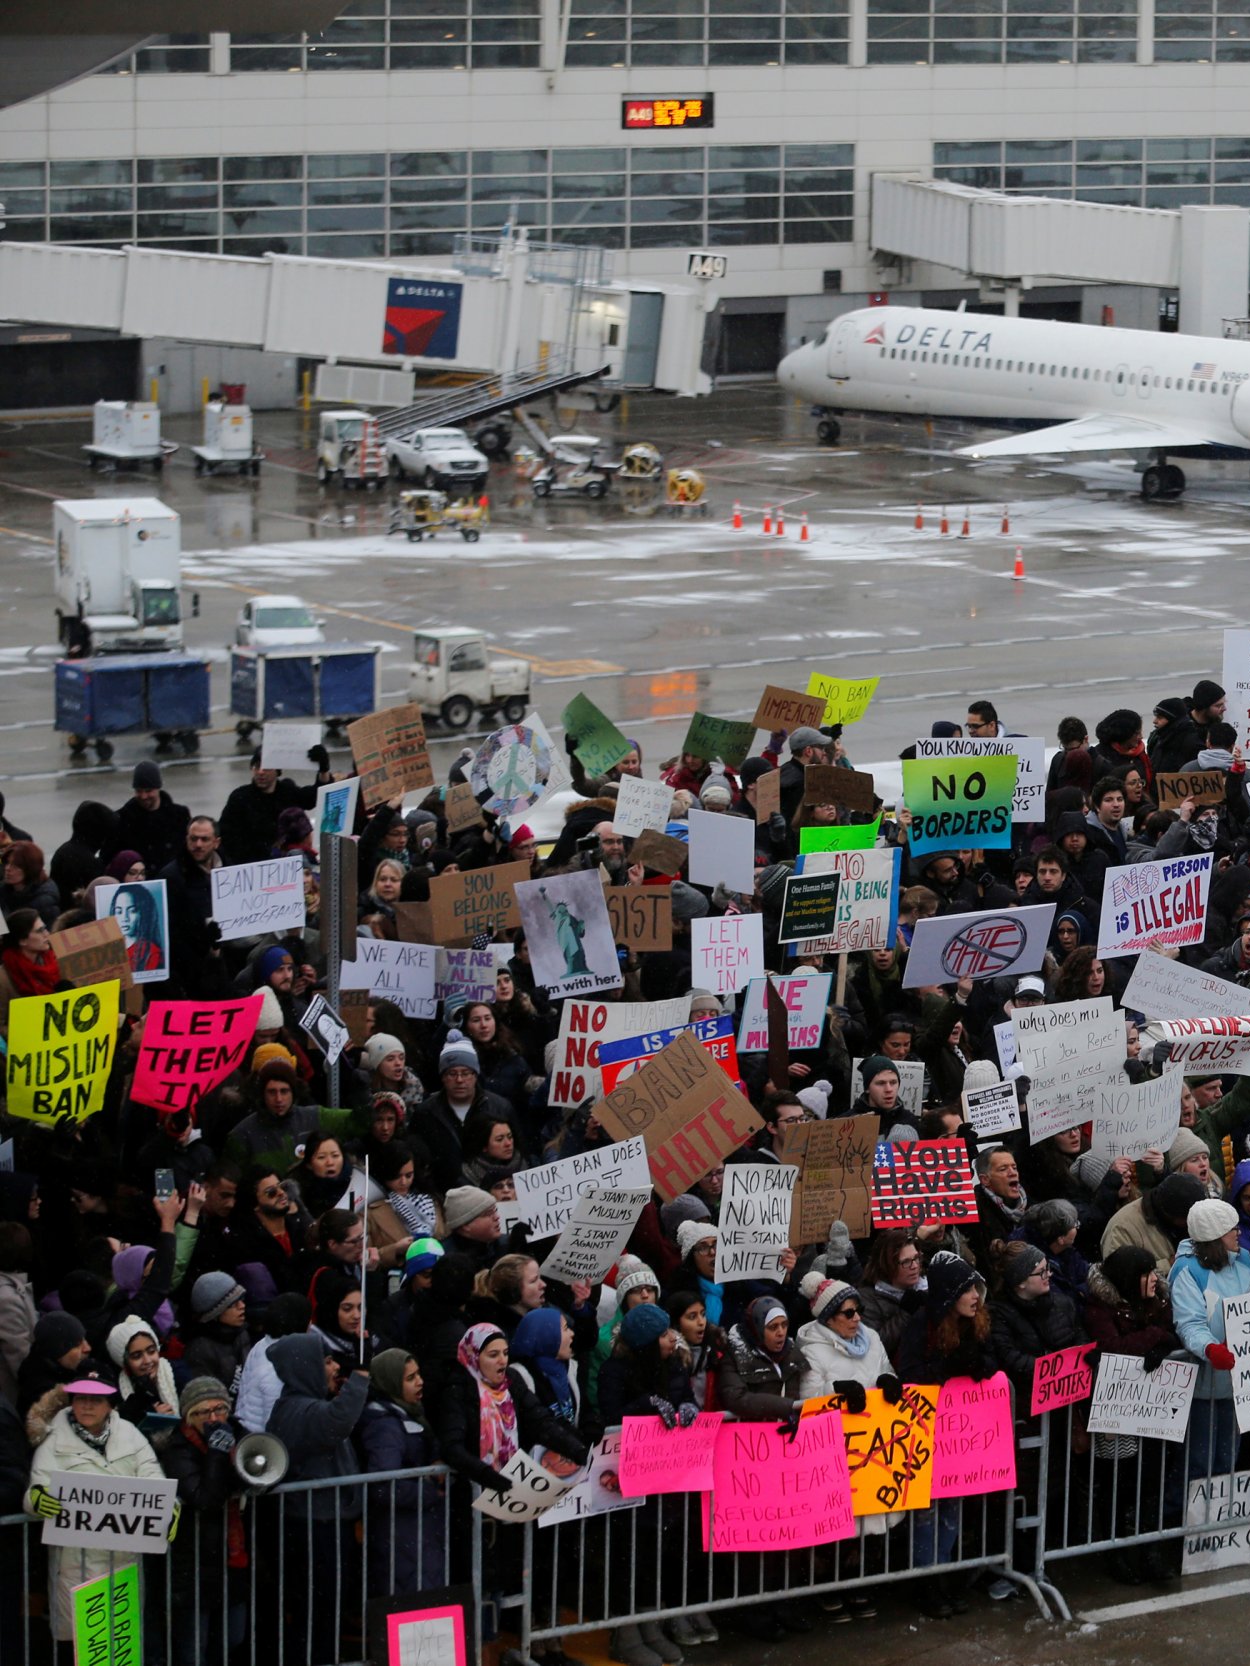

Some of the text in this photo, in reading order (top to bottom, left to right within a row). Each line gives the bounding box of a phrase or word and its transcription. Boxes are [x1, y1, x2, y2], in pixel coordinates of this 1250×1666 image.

[690, 255, 725, 277] A49
[408, 287, 445, 298] DELTA
[896, 325, 991, 352] DELTA
[817, 683, 871, 702] NO BAN
[763, 696, 821, 728] IMPEACH!
[918, 740, 943, 755] YOU
[932, 771, 986, 801] NO
[1160, 773, 1222, 800] NO BAN
[912, 806, 1008, 841] BORDERS
[215, 860, 302, 899] BAN TRUMP
[464, 872, 494, 896] YOU
[791, 881, 835, 894] One Human Family
[855, 880, 888, 900] BEING
[1112, 856, 1210, 908] NO PERSON
[453, 892, 512, 917] BELONG
[838, 905, 852, 921] IS
[1132, 875, 1205, 935] ILLEGAL
[709, 918, 743, 944] LET
[361, 945, 429, 968] WE ARE
[470, 952, 493, 967] ARE
[700, 947, 749, 969] THEM
[563, 972, 621, 991] with her.
[718, 970, 736, 992] IN
[43, 993, 99, 1041] NO
[162, 1007, 245, 1036] LET
[570, 1004, 607, 1032] NO
[9, 1034, 110, 1086] MUSLIM
[143, 1041, 249, 1074] THEM
[606, 1036, 707, 1135] BAN
[1101, 1069, 1180, 1115] NO HUMAN
[33, 1081, 93, 1124] BAN
[980, 1102, 997, 1111] MUSLIM
[980, 1108, 1001, 1117] BORDER
[1097, 1116, 1139, 1135] BEING
[518, 1141, 643, 1193] YOUR BAN DOES
[895, 1141, 962, 1171] You
[732, 1168, 760, 1196] NO
[874, 1168, 963, 1198] Have
[600, 1192, 628, 1204] STAND
[726, 1194, 790, 1226] NO WALL
[589, 1205, 632, 1220] MUSLIMS
[879, 1197, 969, 1229] Rights
[722, 1230, 788, 1247] WE STAND
[1039, 1355, 1064, 1381] DID
[962, 1387, 1007, 1405] nation
[1038, 1370, 1091, 1404] STUTTER?
[734, 1431, 770, 1462] NO
[511, 1461, 550, 1492] NO
[731, 1469, 761, 1499] NO
[59, 1485, 166, 1510] LAND OF THE
[54, 1510, 163, 1537] BRAVE
[713, 1501, 811, 1525] REFUGEES
[713, 1528, 801, 1548] WELCOME
